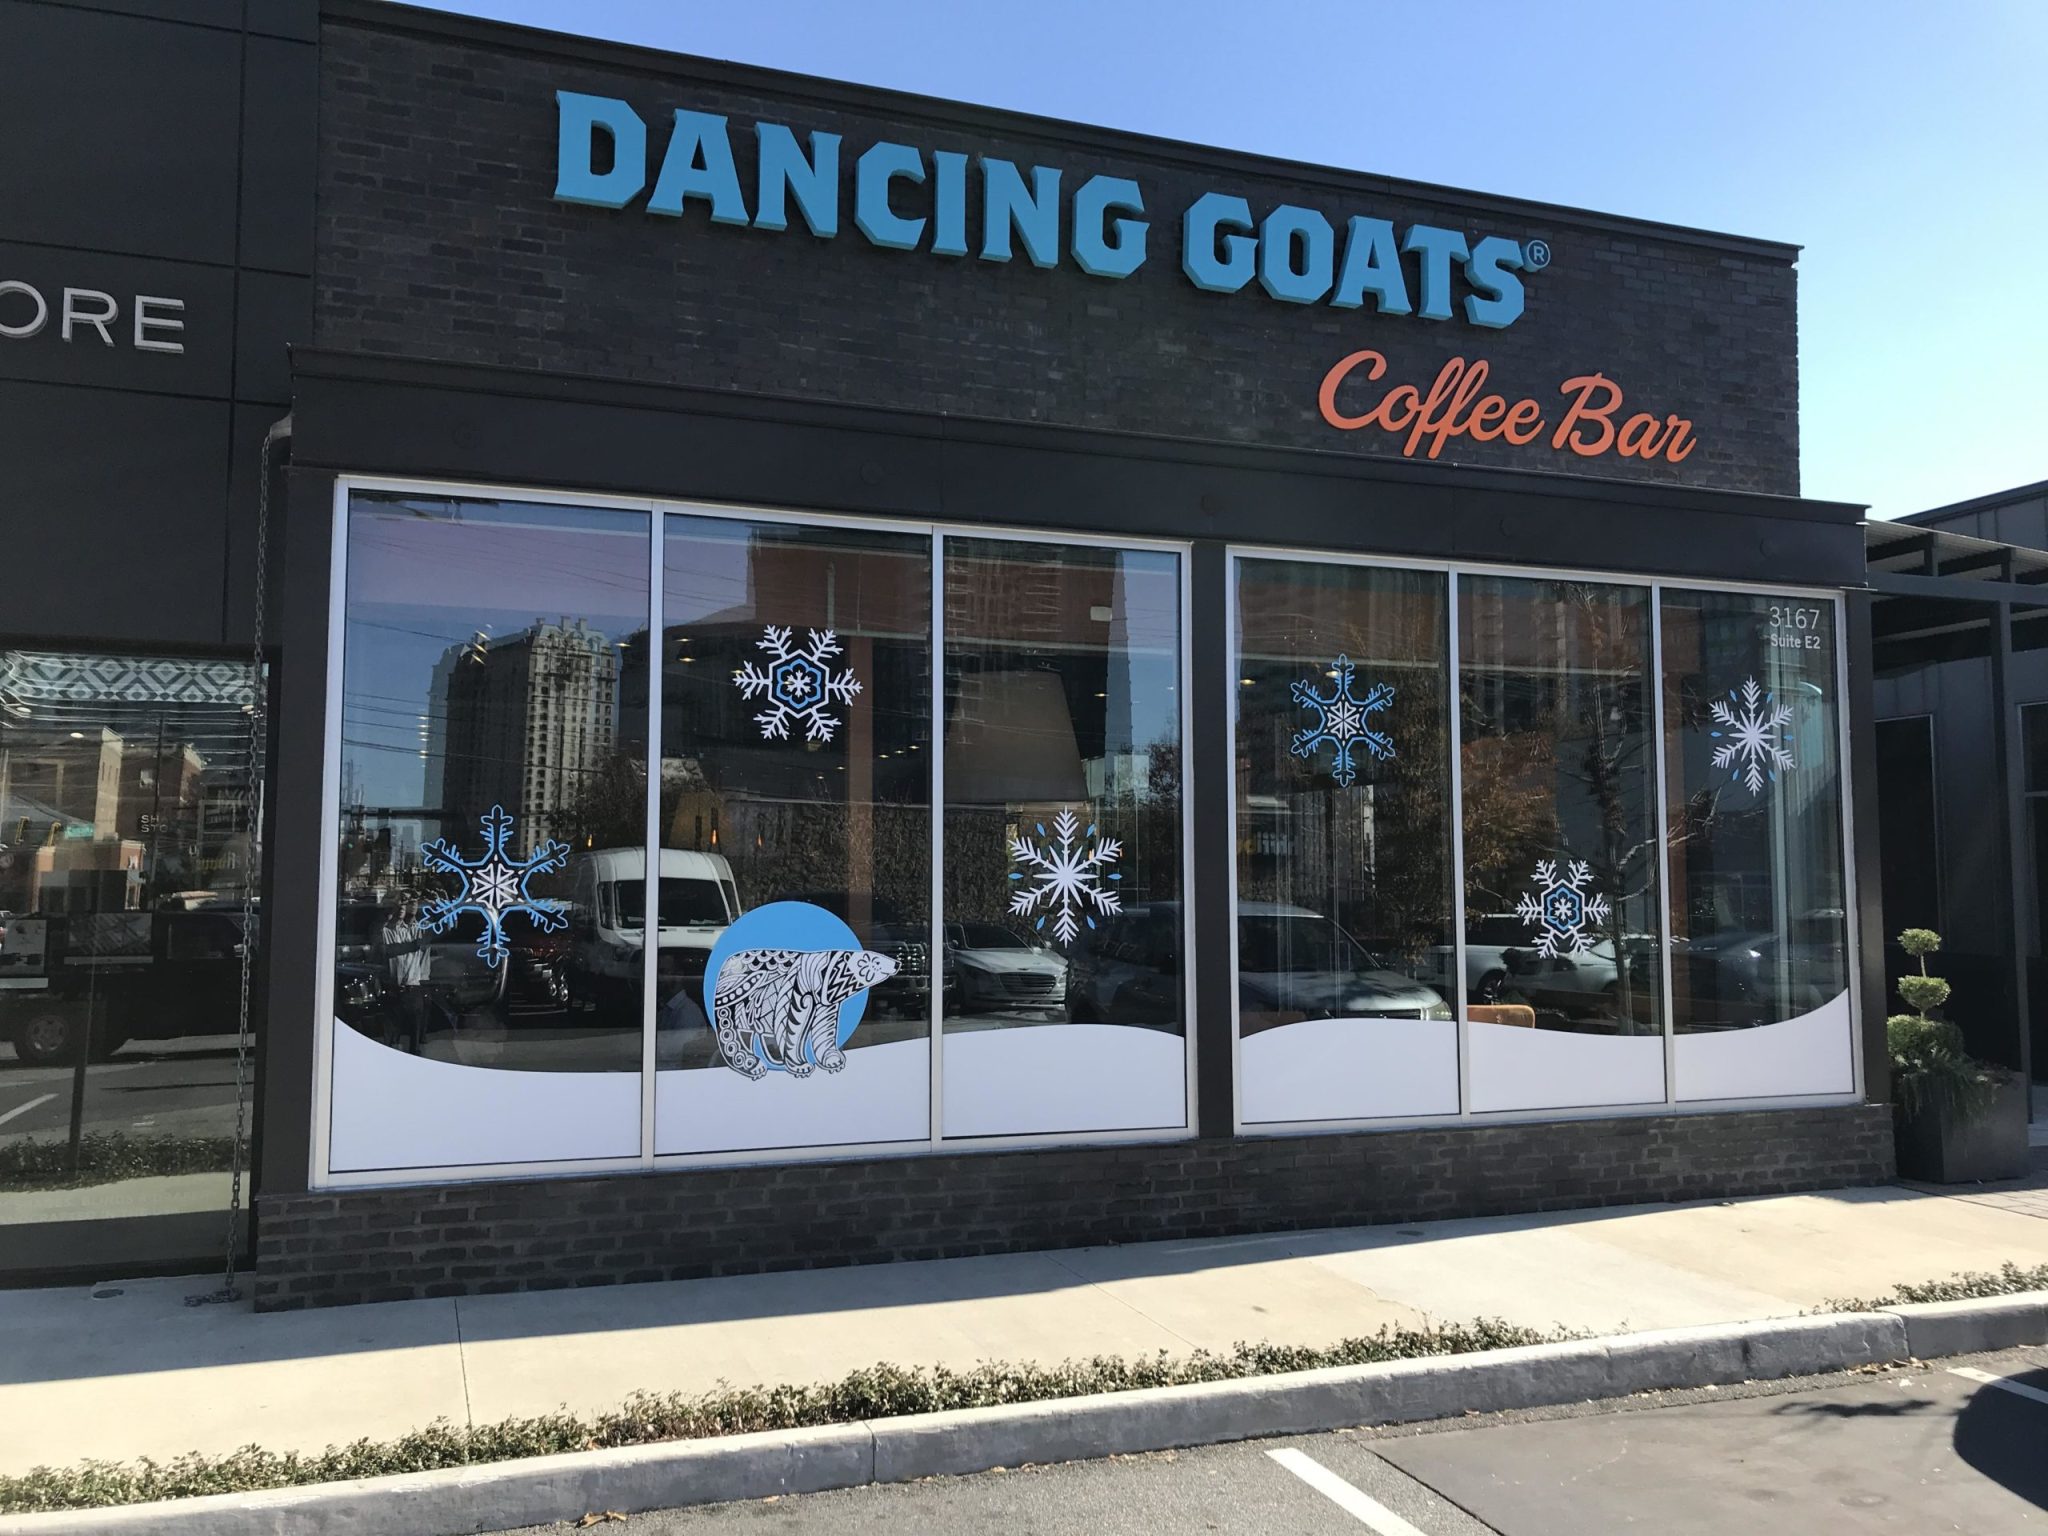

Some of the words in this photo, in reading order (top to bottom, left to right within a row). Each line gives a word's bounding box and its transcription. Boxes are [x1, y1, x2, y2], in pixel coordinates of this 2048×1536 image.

[554, 90, 1151, 279] DANCING
[1182, 192, 1525, 329] GOATS
[1318, 350, 1546, 459] Coffee
[1551, 372, 1698, 463] Bar
[1769, 606, 1820, 630] 3167
[1770, 633, 1801, 648] Suite
[1804, 635, 1821, 650] E2
